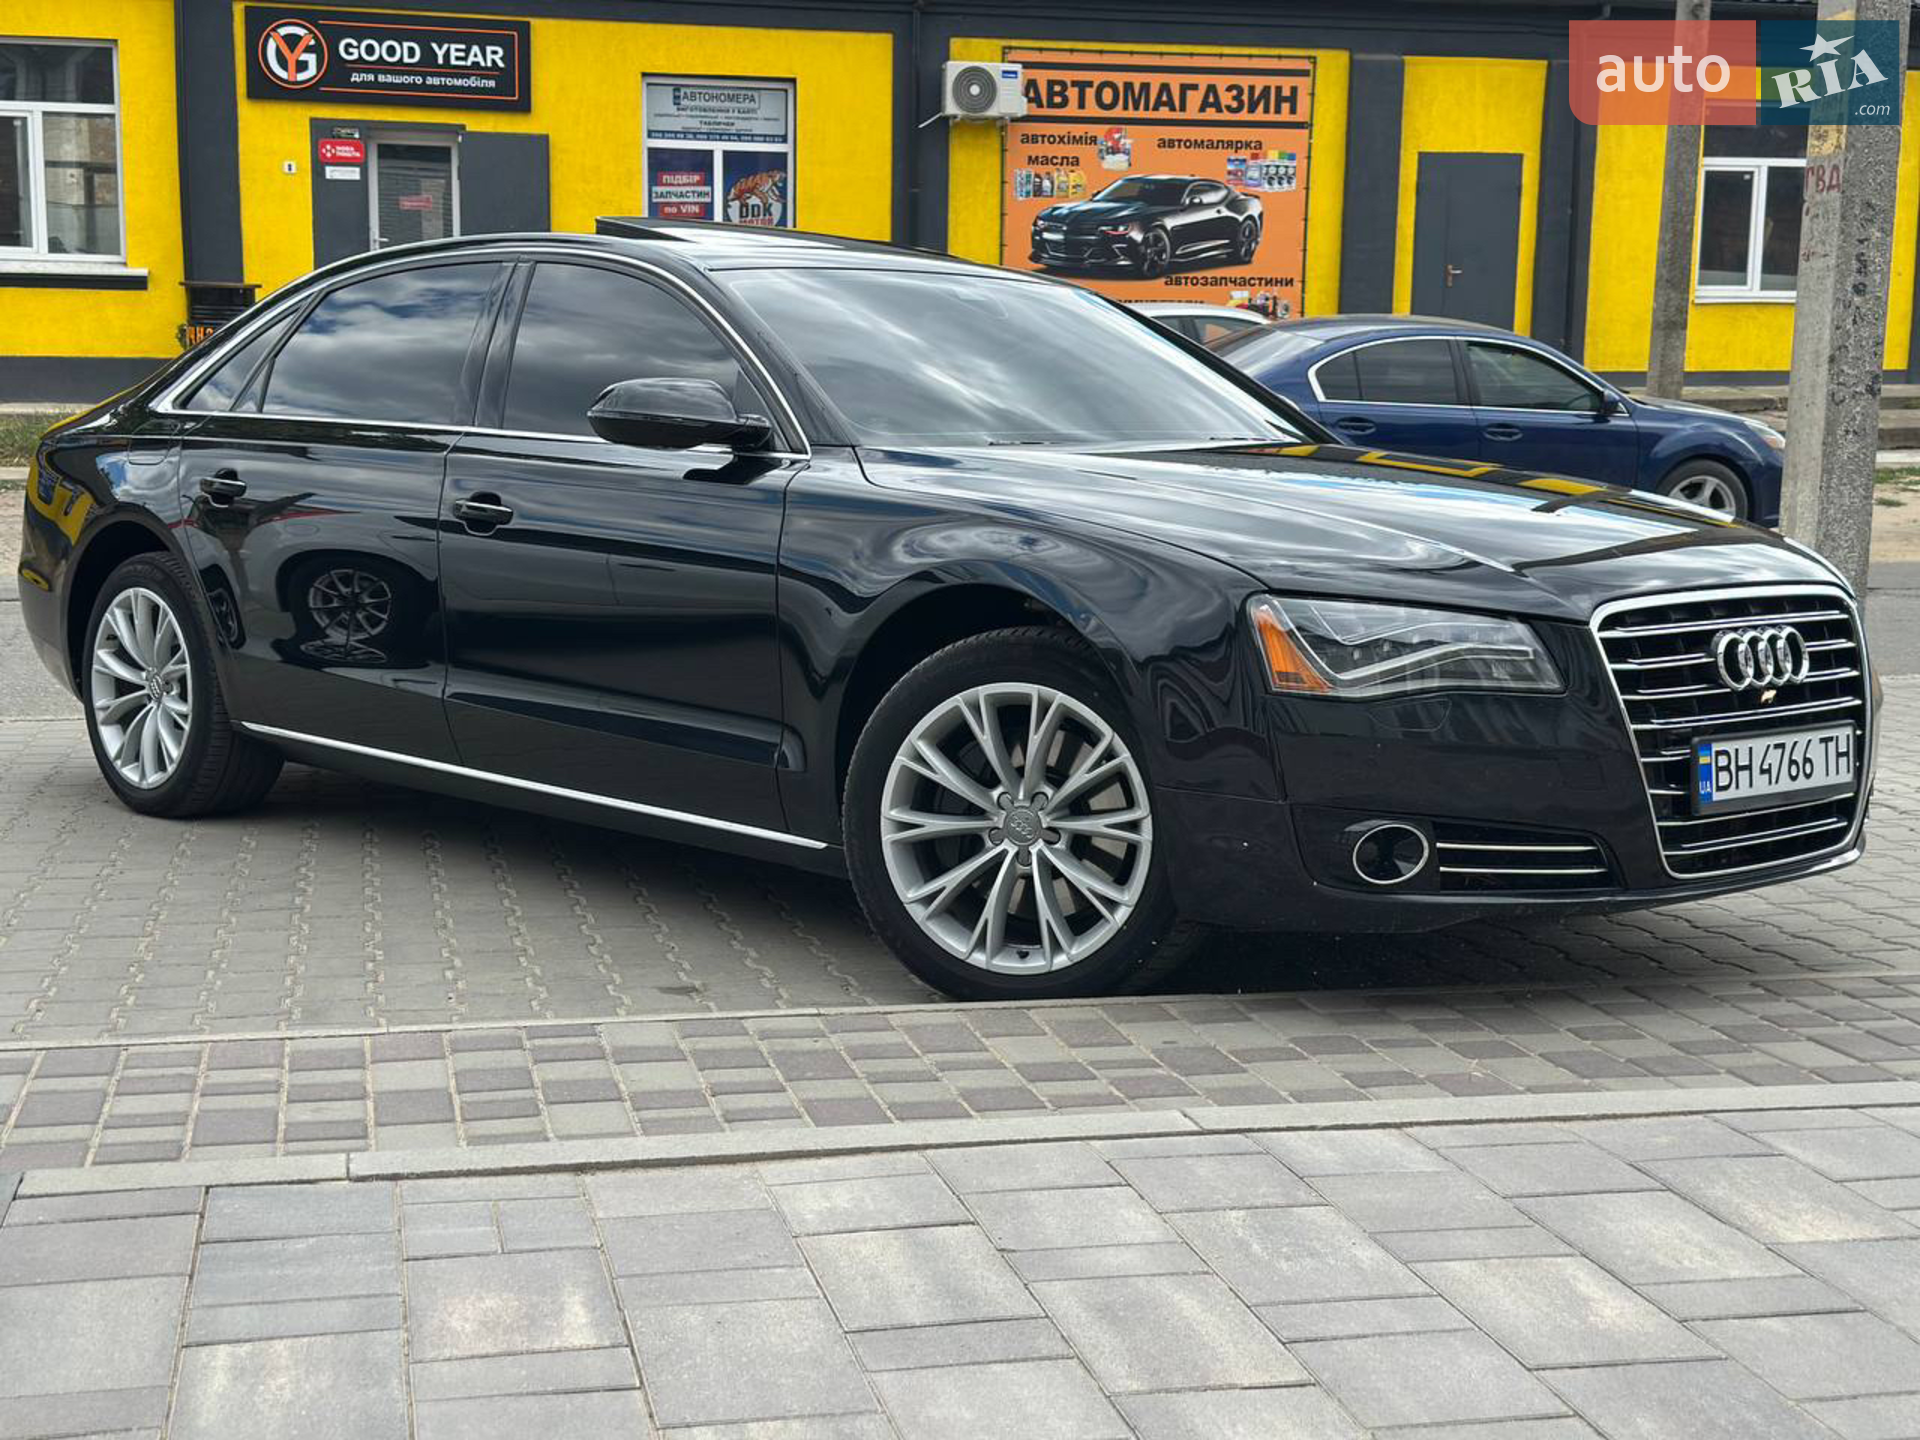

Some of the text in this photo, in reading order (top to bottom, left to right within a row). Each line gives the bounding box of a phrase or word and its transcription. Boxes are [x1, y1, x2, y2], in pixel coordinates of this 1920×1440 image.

[338, 37, 505, 68] GOOD YEAR
[350, 72, 495, 89] для вашого автомобіля
[682, 91, 757, 104] АВТОНОМЕРА
[1024, 78, 1298, 115] АВТОМАГАЗИН
[1020, 131, 1263, 154] автохімія автомалярка
[1027, 154, 1080, 167] масла
[662, 174, 701, 185] ПІДБІР
[653, 190, 710, 200] ЗАПЧАСТИН
[663, 203, 700, 214] по VIN
[1164, 274, 1294, 287] автозапчастини
[1714, 733, 1851, 792] BH 4766 TH
[1699, 780, 1712, 794] UA
